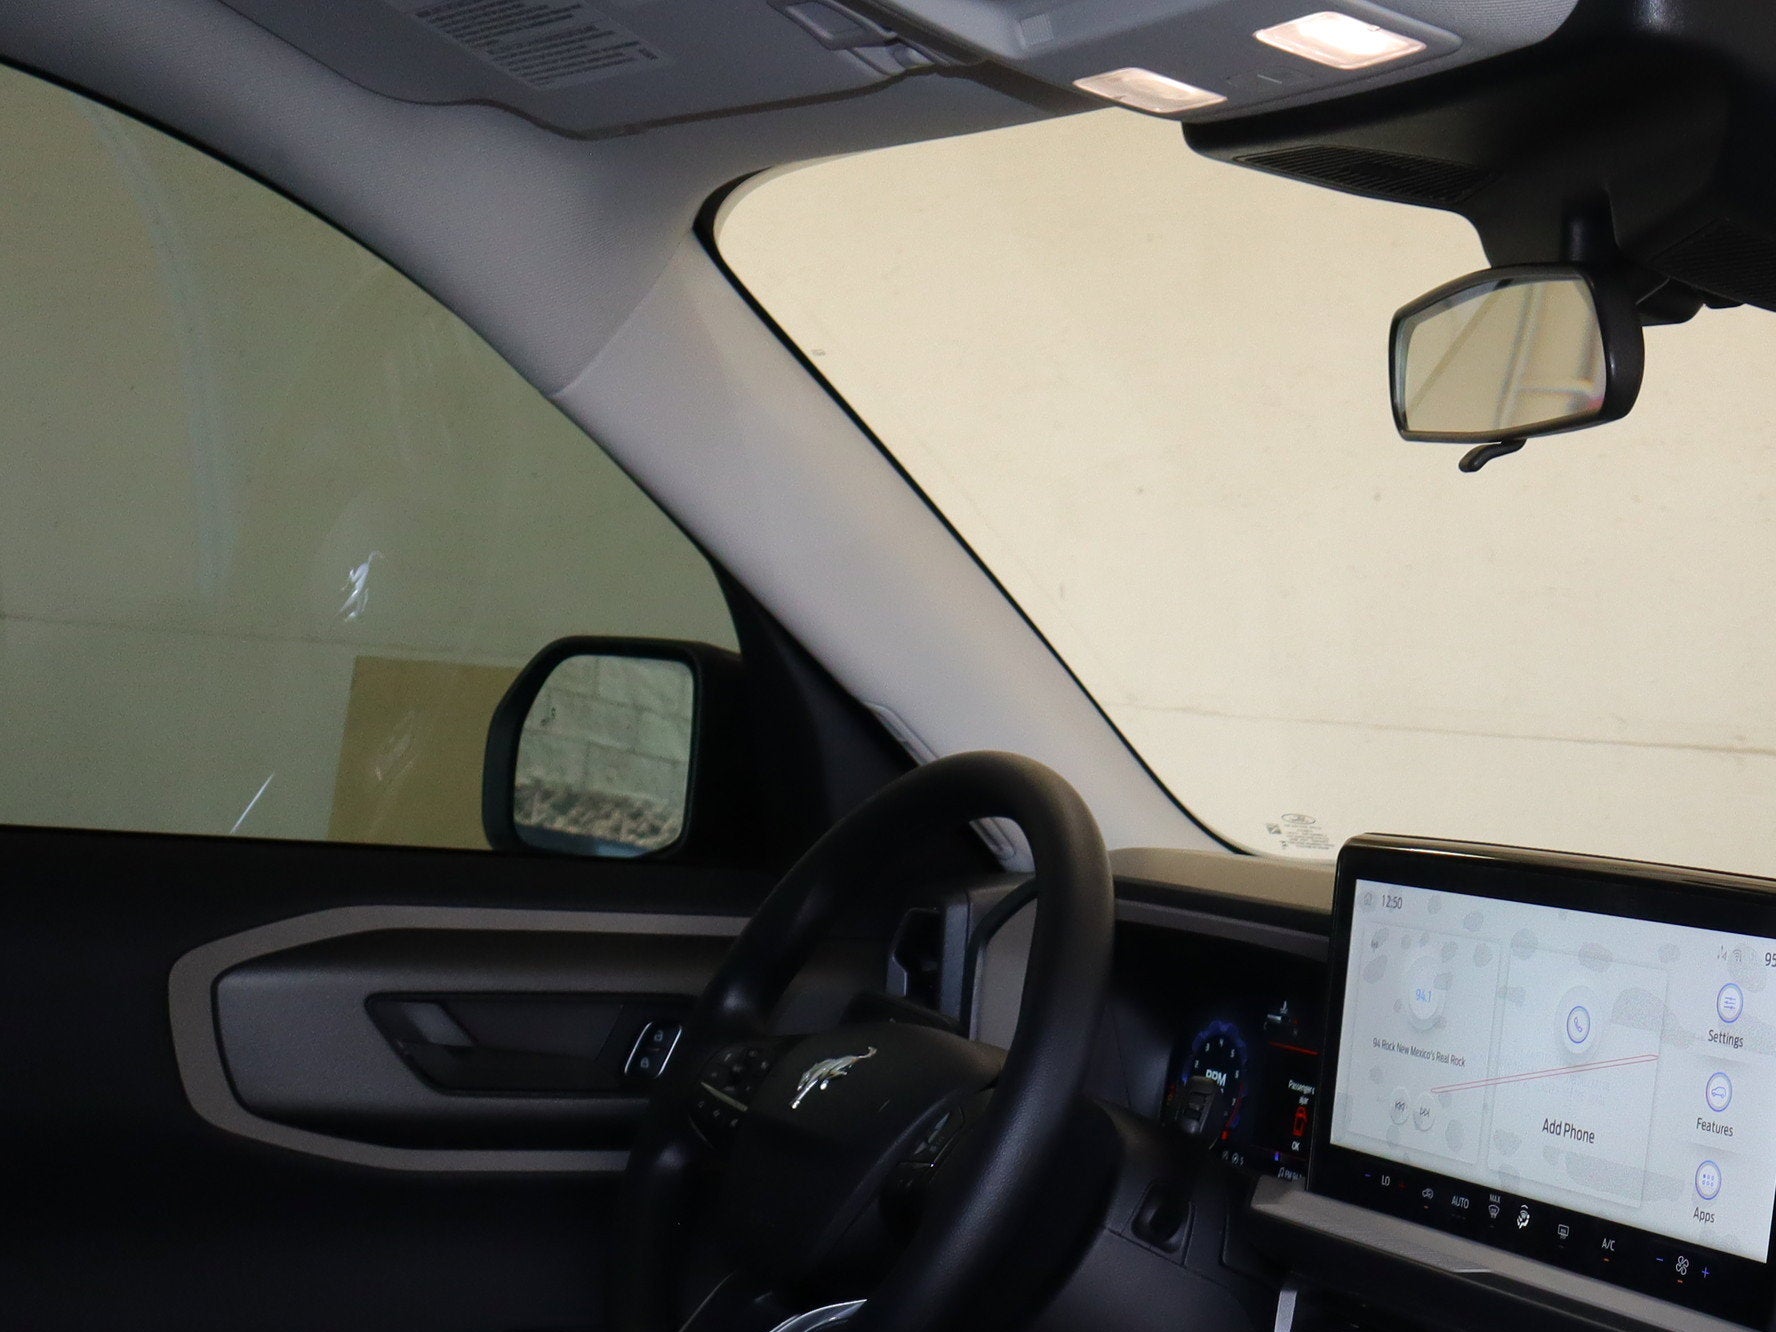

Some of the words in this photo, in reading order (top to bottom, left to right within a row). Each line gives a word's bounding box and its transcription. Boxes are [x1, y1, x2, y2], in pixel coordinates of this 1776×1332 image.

[1707, 1029, 1744, 1049] Settings
[1372, 1037, 1381, 1049] 94
[1381, 1039, 1397, 1052] Rock
[1397, 1043, 1410, 1056] New
[1410, 1045, 1436, 1061] Mexico's
[1436, 1051, 1450, 1064] Real
[1450, 1054, 1466, 1068] Rock
[1541, 1118, 1562, 1137] Add
[1562, 1122, 1596, 1144] Phone
[1695, 1117, 1734, 1137] Features
[1381, 1175, 1391, 1187] LO
[1451, 1195, 1470, 1210] AUTO
[1692, 1206, 1716, 1224] Apps
[1601, 1237, 1616, 1251] A/C
